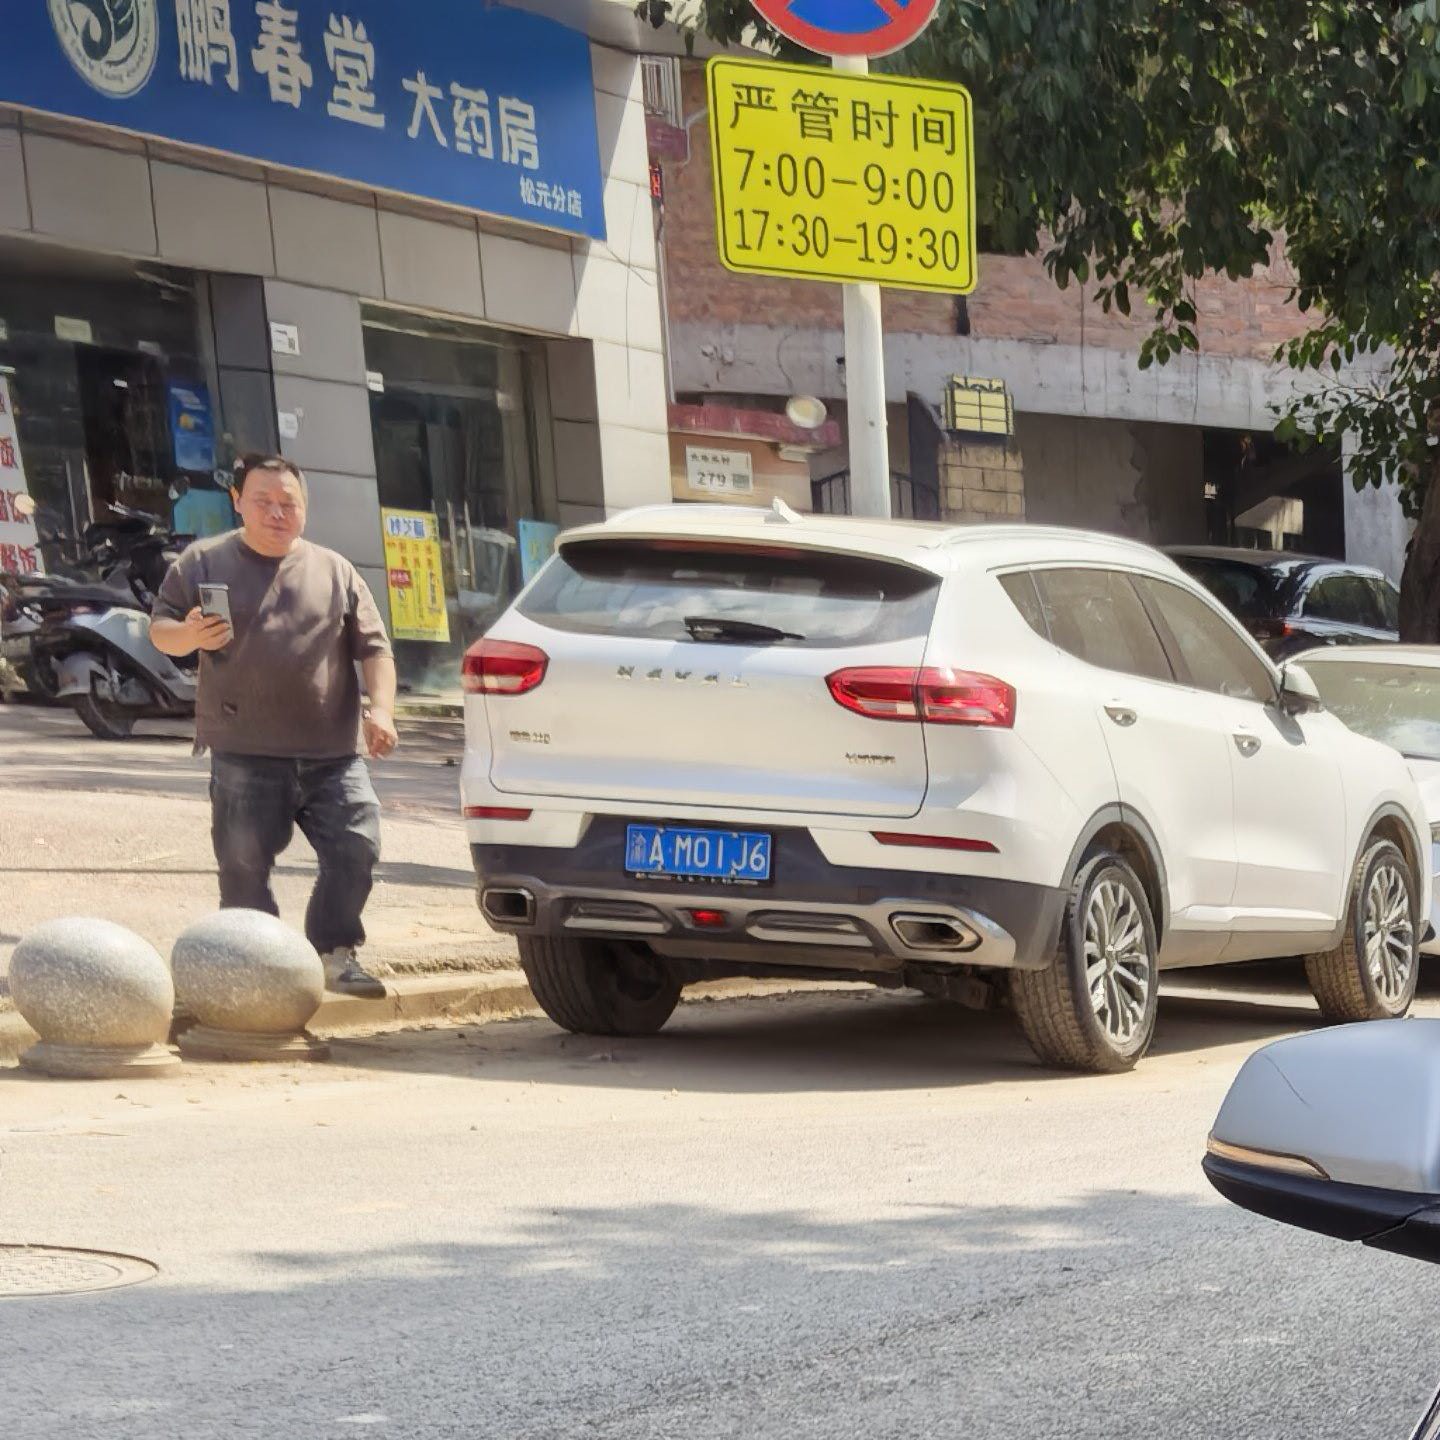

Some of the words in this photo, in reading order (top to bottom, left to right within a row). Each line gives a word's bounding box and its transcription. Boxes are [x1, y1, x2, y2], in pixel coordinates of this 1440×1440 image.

[175, 0, 386, 129] 鹏春堂
[402, 70, 540, 171] 大药房
[729, 82, 956, 156] 严管时间
[519, 174, 583, 219] 松元分店
[733, 147, 954, 214] 7:00-9:00
[734, 208, 960, 272] 17:30-19:30
